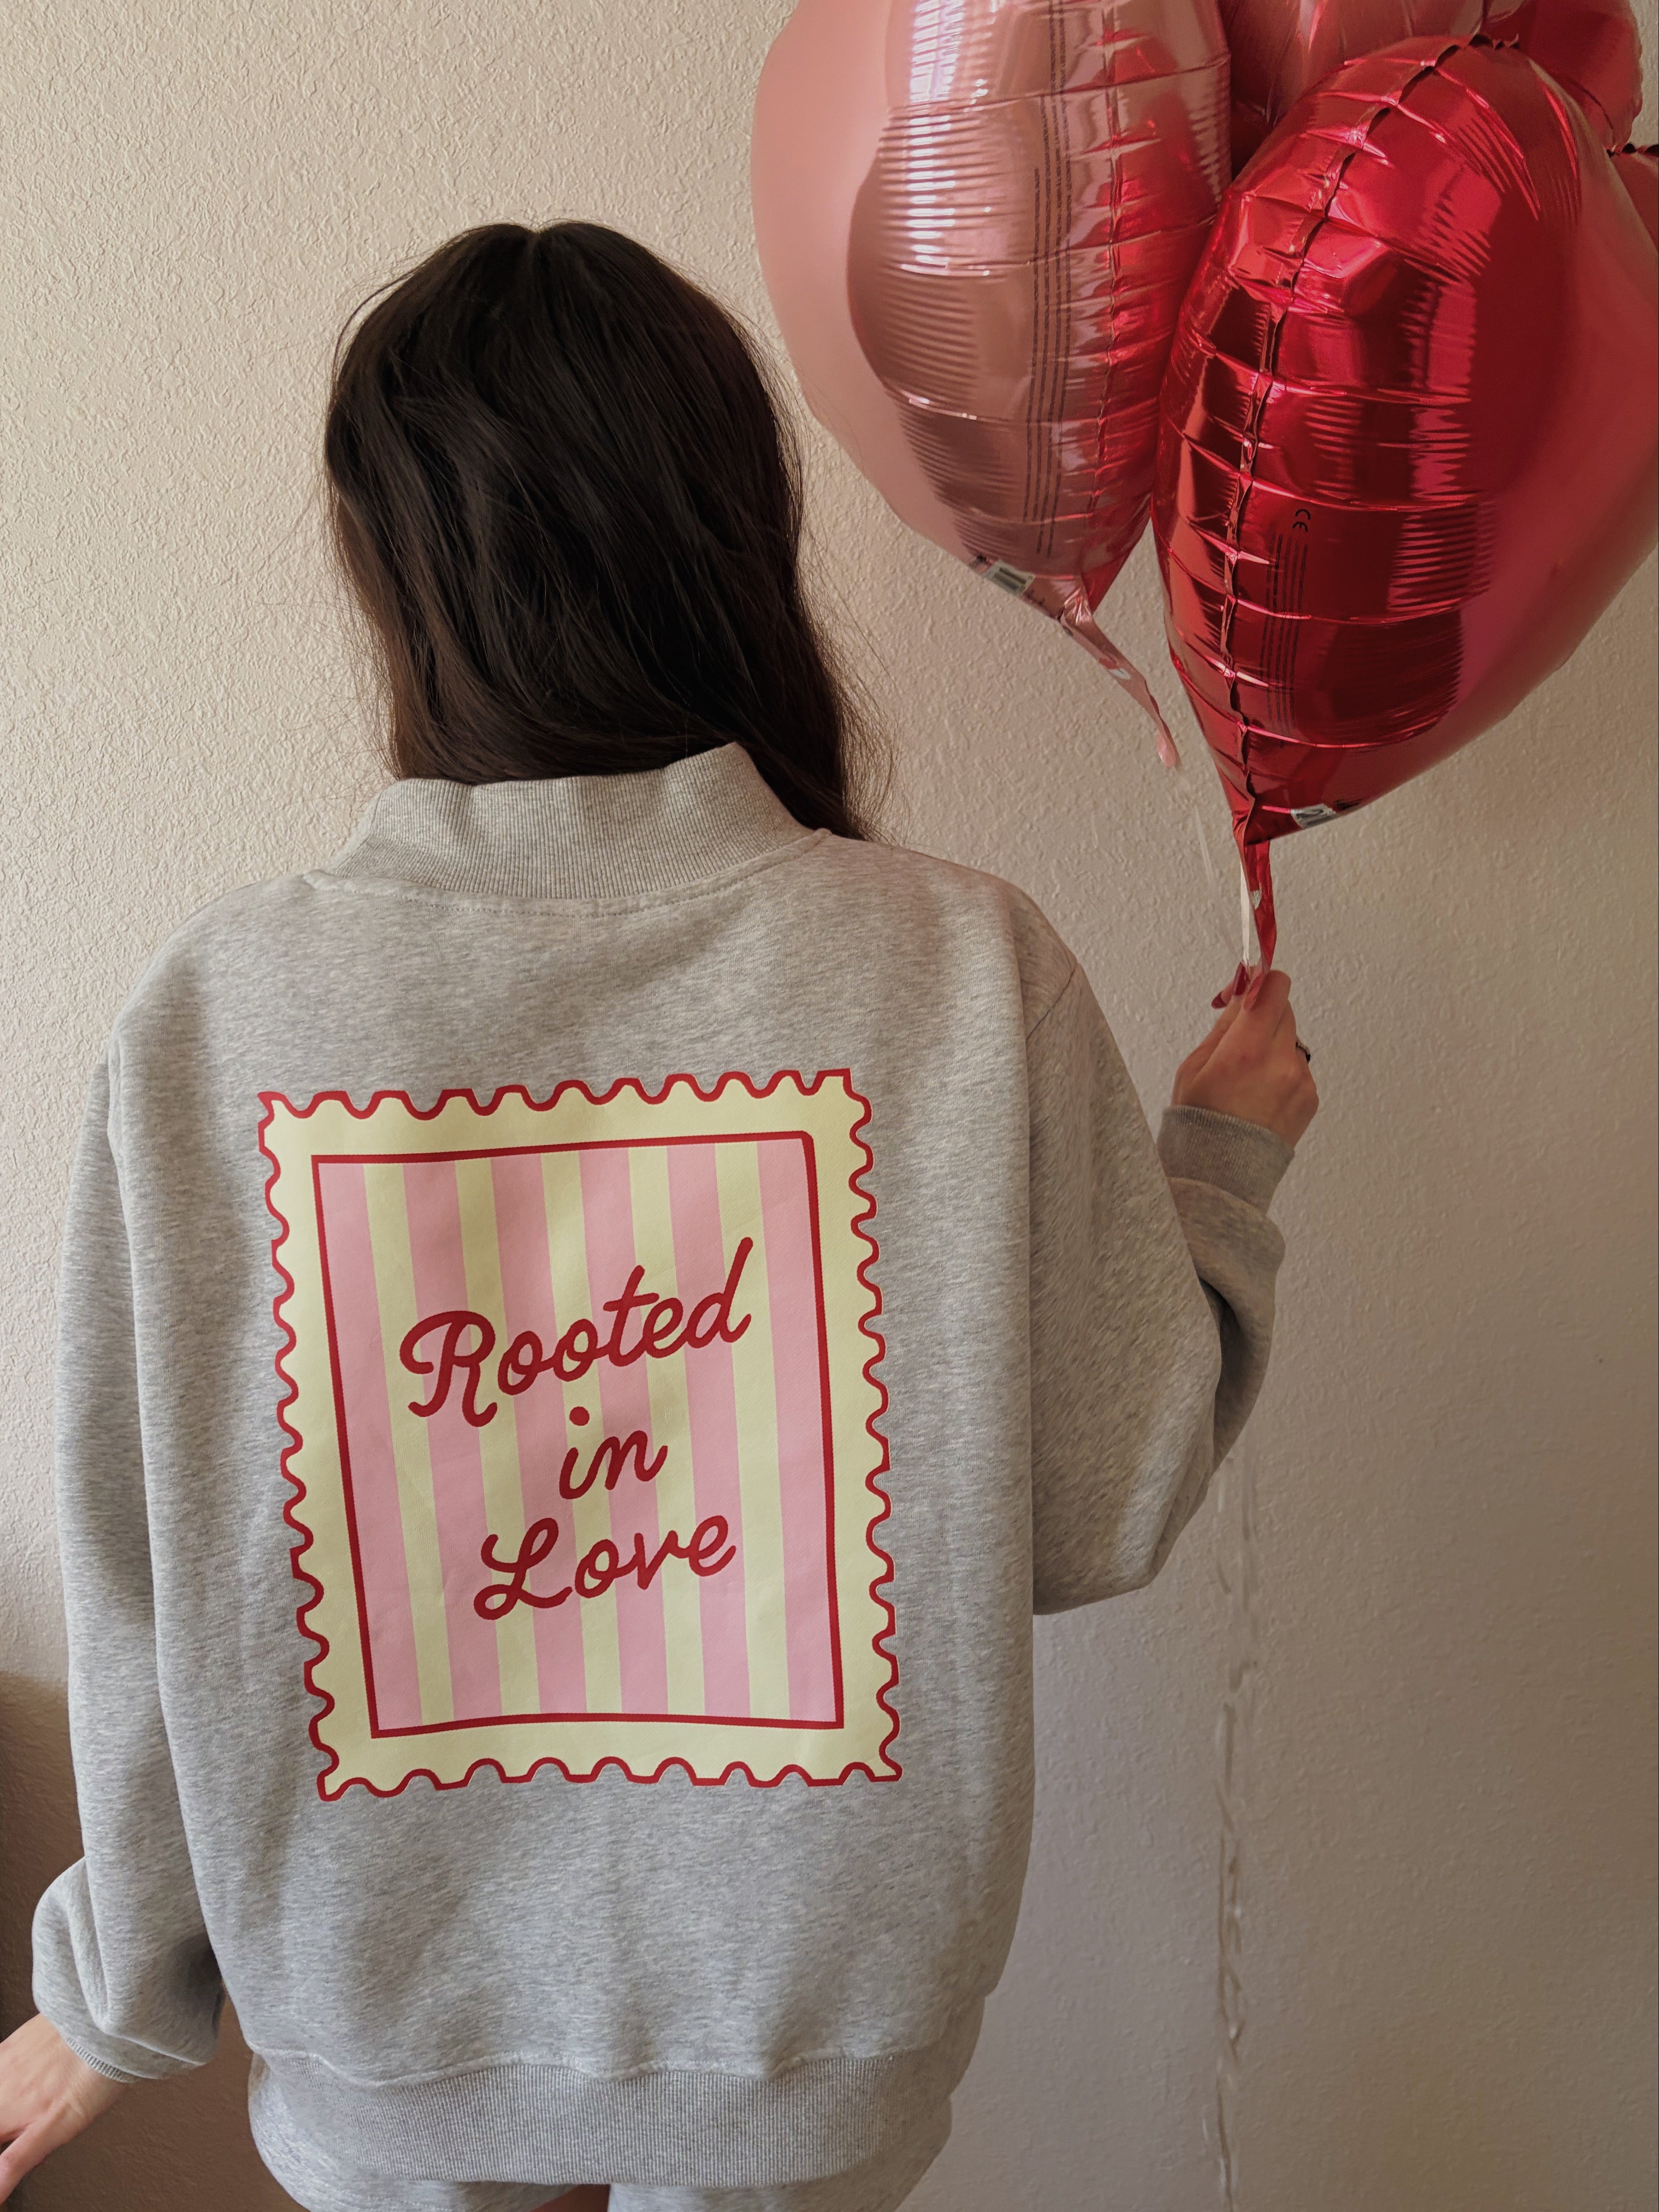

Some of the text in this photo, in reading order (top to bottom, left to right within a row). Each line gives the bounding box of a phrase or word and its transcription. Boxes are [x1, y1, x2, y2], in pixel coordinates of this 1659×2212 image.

[400, 1237, 753, 1427] Rooted
[559, 1407, 667, 1500] in
[474, 1515, 737, 1620] Love
